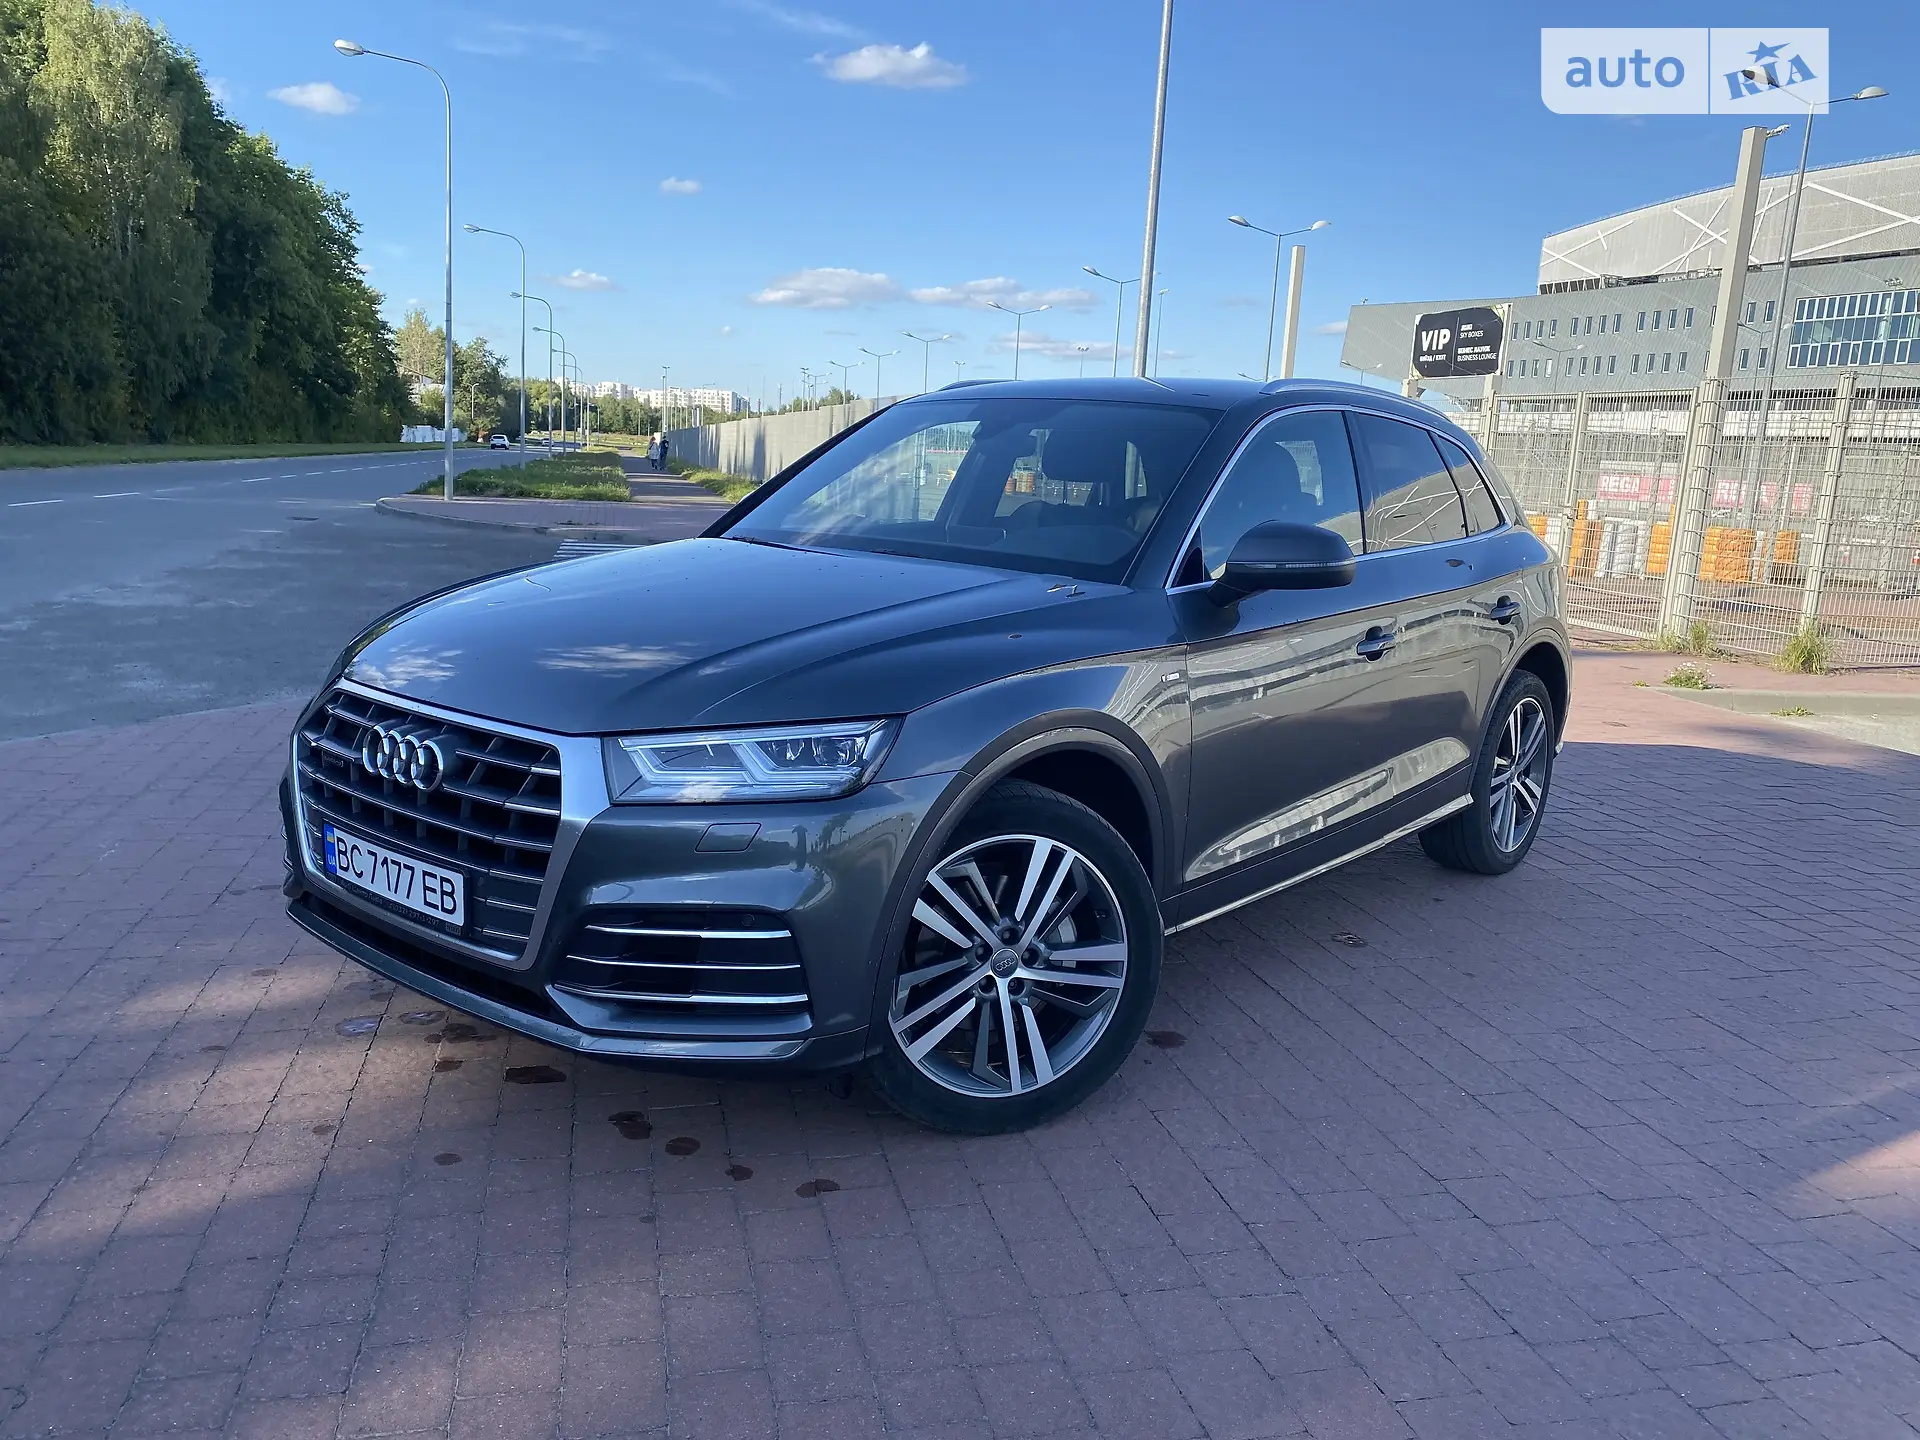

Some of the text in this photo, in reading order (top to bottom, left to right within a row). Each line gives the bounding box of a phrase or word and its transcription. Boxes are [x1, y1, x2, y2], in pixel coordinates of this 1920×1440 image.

[1421, 329, 1451, 352] VIP
[1457, 353, 1498, 362] BUSINESS LOUNGE
[327, 854, 335, 867] UA
[336, 835, 457, 915] BC 7177 EB
